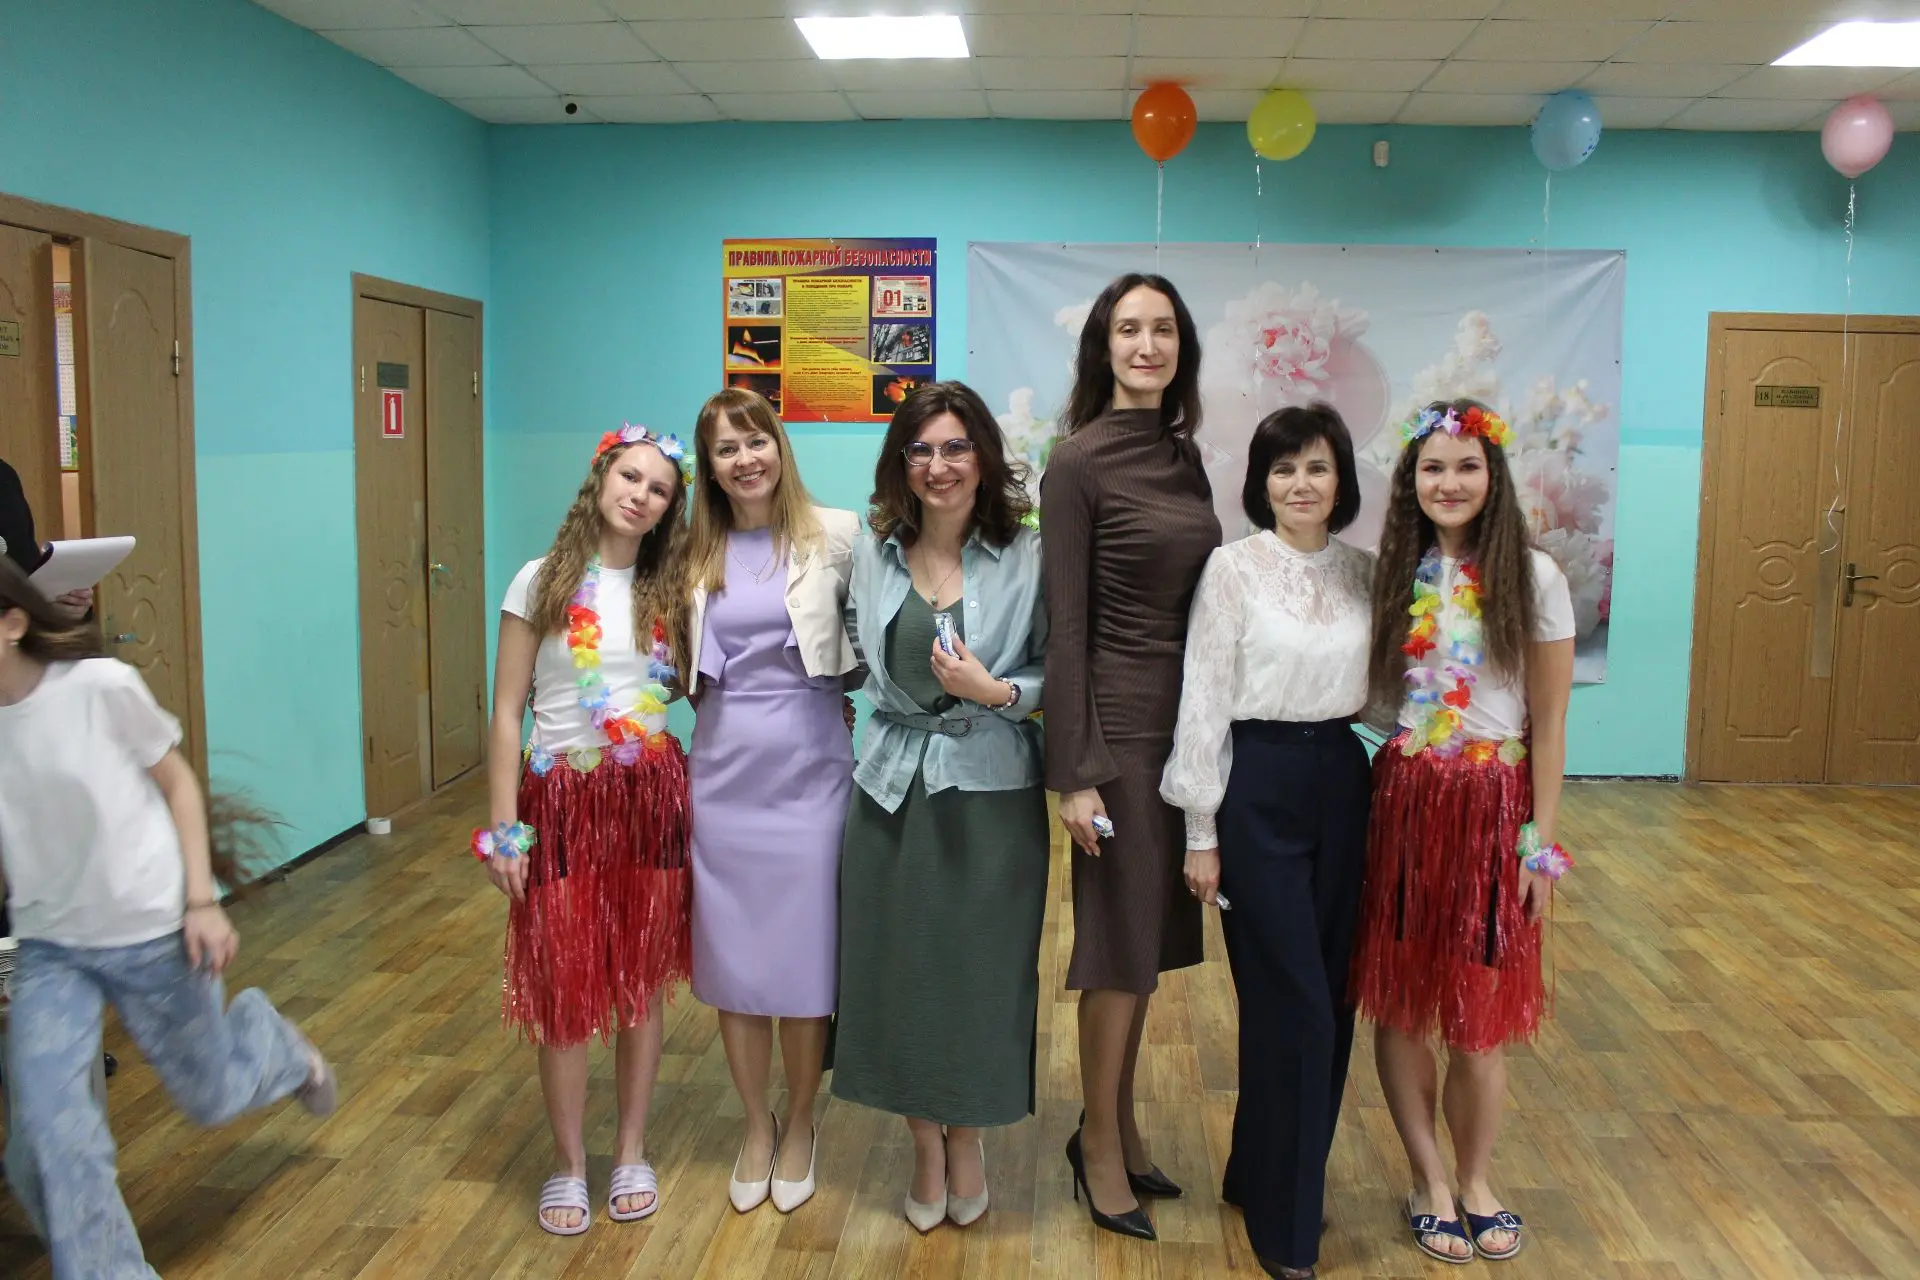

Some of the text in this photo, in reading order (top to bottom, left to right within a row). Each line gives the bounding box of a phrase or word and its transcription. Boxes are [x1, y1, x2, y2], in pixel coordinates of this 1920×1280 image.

[729, 245, 932, 267] ПРАВИЛА ПОЖАРНОЙ БЕЗОПАСНОСТИ
[883, 289, 901, 307] 01
[1760, 391, 1769, 400] 18
